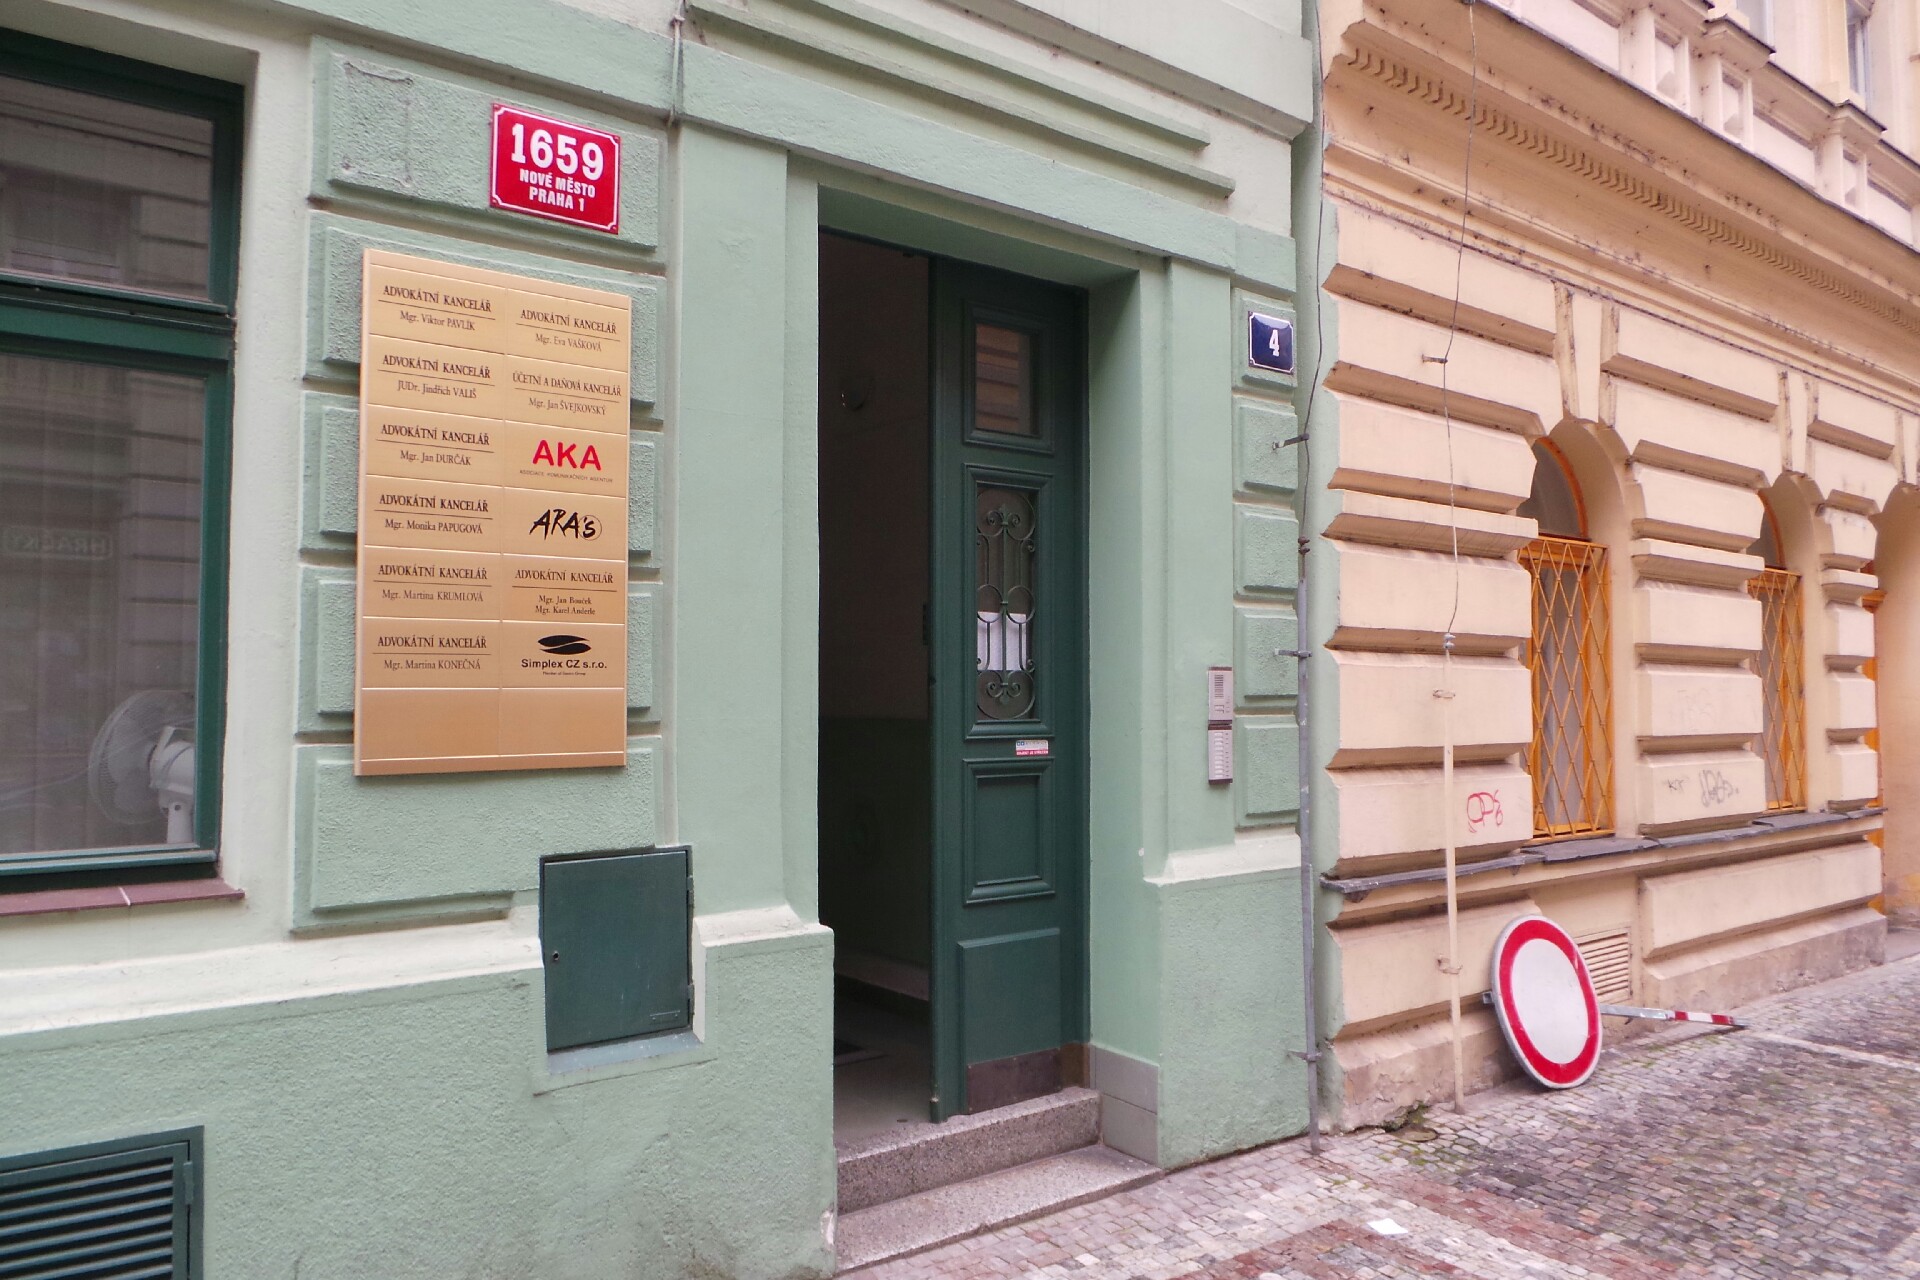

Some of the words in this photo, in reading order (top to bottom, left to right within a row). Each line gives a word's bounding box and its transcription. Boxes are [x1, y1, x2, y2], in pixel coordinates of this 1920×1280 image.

[511, 123, 604, 180] 1659
[520, 168, 553, 188] NOVÉ
[555, 176, 596, 198] MĚSTO
[529, 186, 574, 209] PRAHA
[579, 198, 585, 212] 1
[383, 285, 439, 303] ADVOKÁTNÍ
[443, 294, 491, 312] KANCELÁŘ
[400, 310, 419, 323] Mgr.
[421, 313, 445, 325] Viktor
[447, 317, 475, 330] PAVLÍK
[520, 309, 570, 326] ADVOKÁTNÍ
[574, 318, 616, 334] KANCELÁŘ
[535, 333, 552, 345] Mgr.
[553, 336, 566, 346] Eva
[568, 337, 602, 352] VAŠKOVÁ
[1269, 329, 1280, 357] 4
[382, 354, 438, 371] ADVOKÁTNÍ
[443, 362, 490, 378] KANCELÁŘ
[397, 380, 420, 392] JUDr.
[422, 383, 450, 396] Jindřich
[453, 387, 477, 398] VALIŠ
[512, 370, 541, 385] ÚČETNÍ
[543, 377, 549, 386] A
[551, 378, 581, 391] DAŇOVÁ
[583, 382, 621, 396] KANCELÁŘ
[528, 397, 545, 409] Mgr.
[547, 400, 558, 410] Jan
[560, 400, 606, 415] ŠVEJKOVSKÝ
[381, 424, 437, 439] ADVOKÁTNÍ
[442, 430, 489, 445] KANCELÁŘ
[400, 450, 419, 462] Mgr.
[421, 452, 434, 463] Jan
[436, 452, 471, 466] DURČÁK
[532, 439, 601, 471] AKA
[379, 494, 436, 508] ADVOKÁTNÍ
[440, 498, 488, 512] KANCELÁŘ
[385, 518, 404, 530] Mgr.
[406, 519, 436, 531] Monika
[438, 522, 483, 534] PAPUGOVÁ
[378, 564, 435, 577] ADVOKÁTNÍ
[439, 567, 487, 580] KANCELÁŘ
[515, 568, 567, 581] ADVOKÁTNÍ
[571, 571, 613, 584] KANCELÁŘ
[382, 589, 401, 601] Mgr.
[403, 589, 434, 600] Martina
[437, 590, 484, 602] KRUMLOVÁ
[538, 595, 554, 605] Mgr.
[556, 595, 567, 605] Jan
[535, 605, 551, 615] Mgr.
[553, 605, 570, 614] Karel
[571, 606, 596, 615] Anderle
[377, 634, 434, 648] ADVOKÁTNÍ
[438, 635, 487, 648] KANCELÁŘ
[384, 659, 403, 671] Mgr.
[405, 659, 436, 669] Martina
[438, 658, 481, 670] KONEČNÁ
[521, 658, 563, 670] Simplex
[566, 659, 580, 669] CZ
[582, 660, 607, 669] s.r.o.
